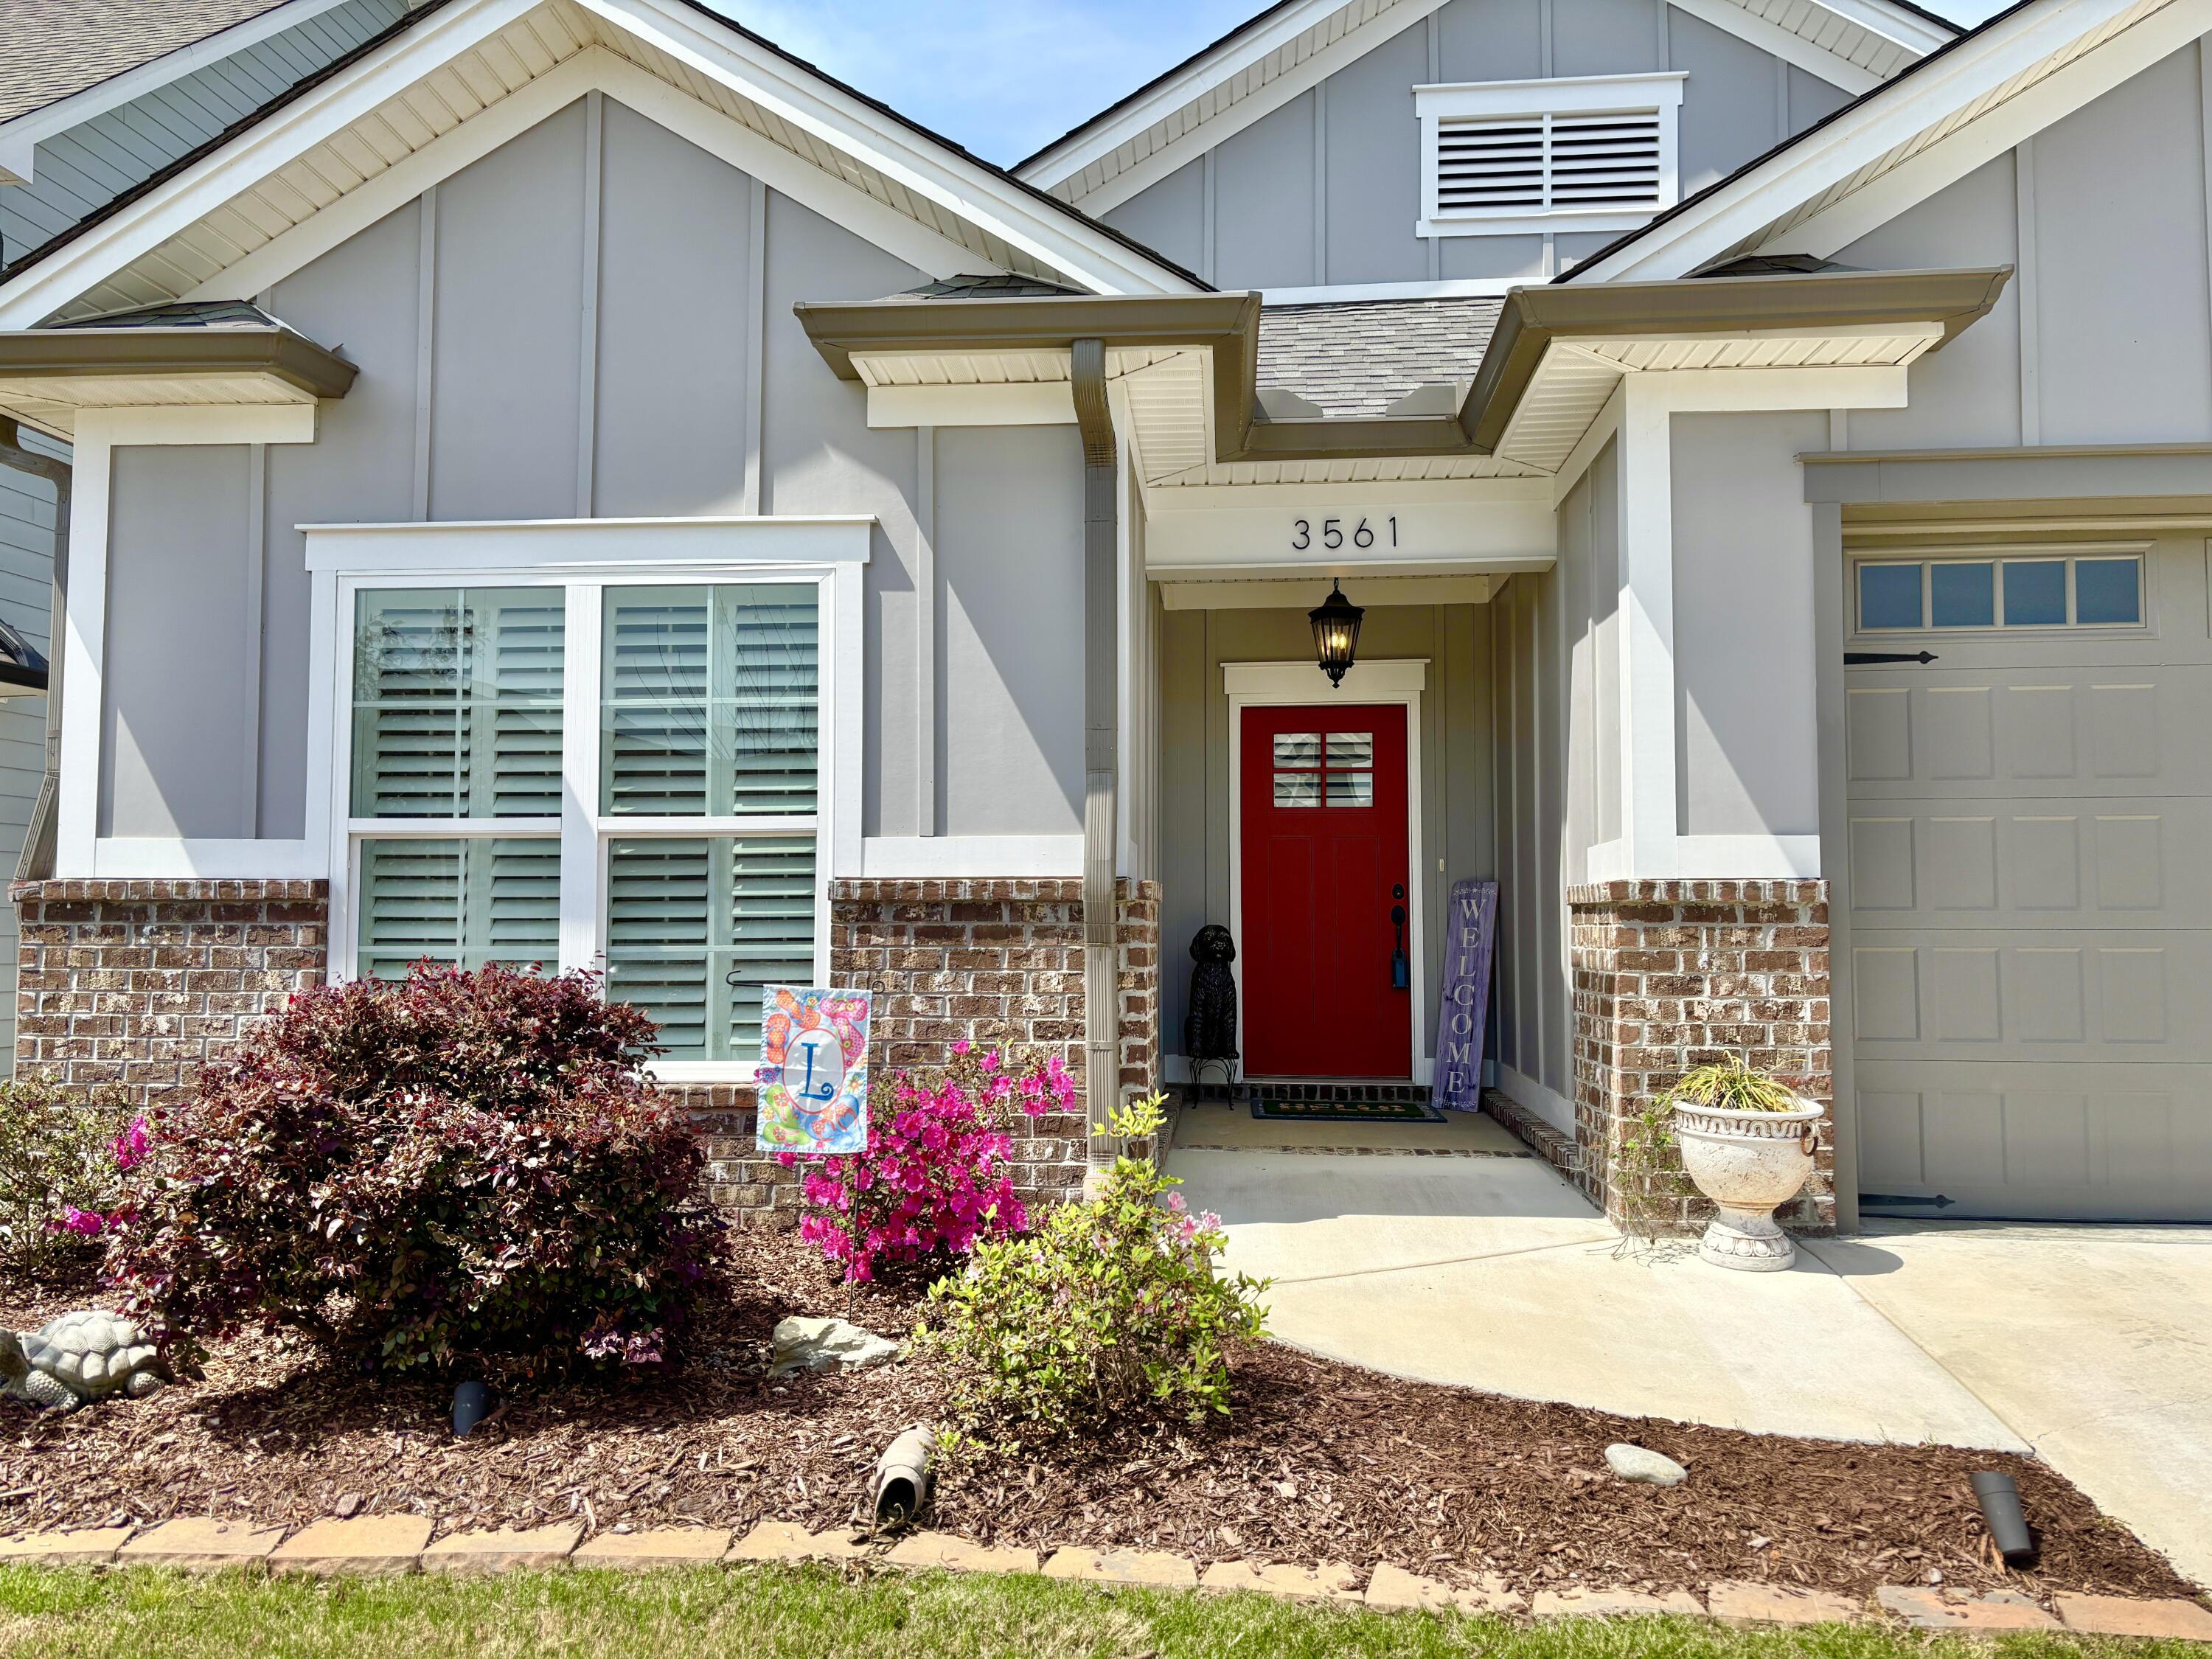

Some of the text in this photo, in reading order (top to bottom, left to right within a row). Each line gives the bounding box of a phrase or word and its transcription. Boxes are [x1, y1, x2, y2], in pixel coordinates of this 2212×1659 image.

[1292, 516, 1397, 549] 3561
[1445, 899, 1486, 1093] WELCOME
[799, 1042, 834, 1101] L
